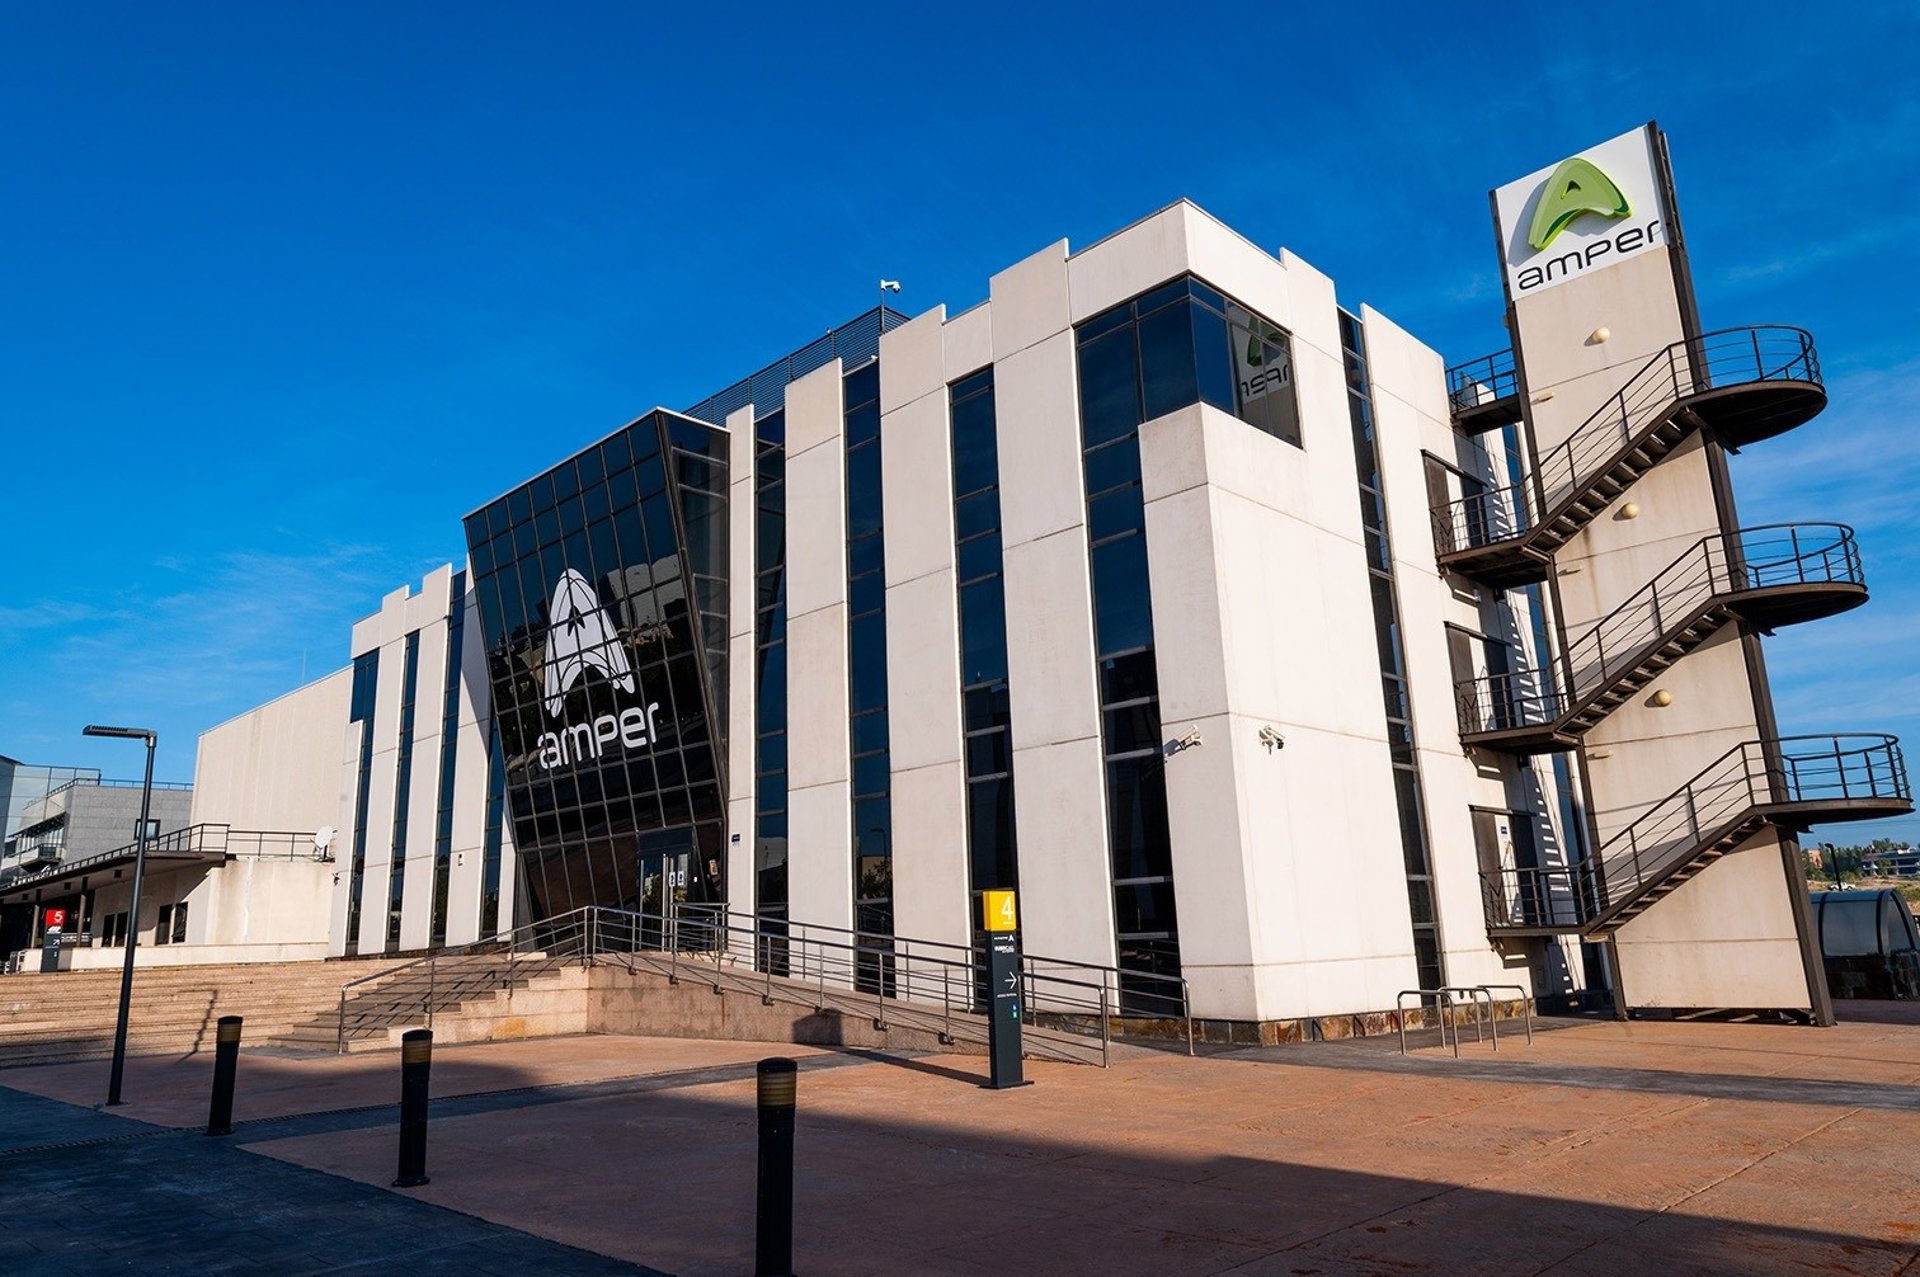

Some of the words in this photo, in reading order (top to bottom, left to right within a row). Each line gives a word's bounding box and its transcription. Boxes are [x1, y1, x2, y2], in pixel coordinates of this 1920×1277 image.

[1517, 219, 1660, 290] amper
[537, 702, 659, 769] amper
[54, 910, 63, 922] 5
[1001, 895, 1014, 921] 4
